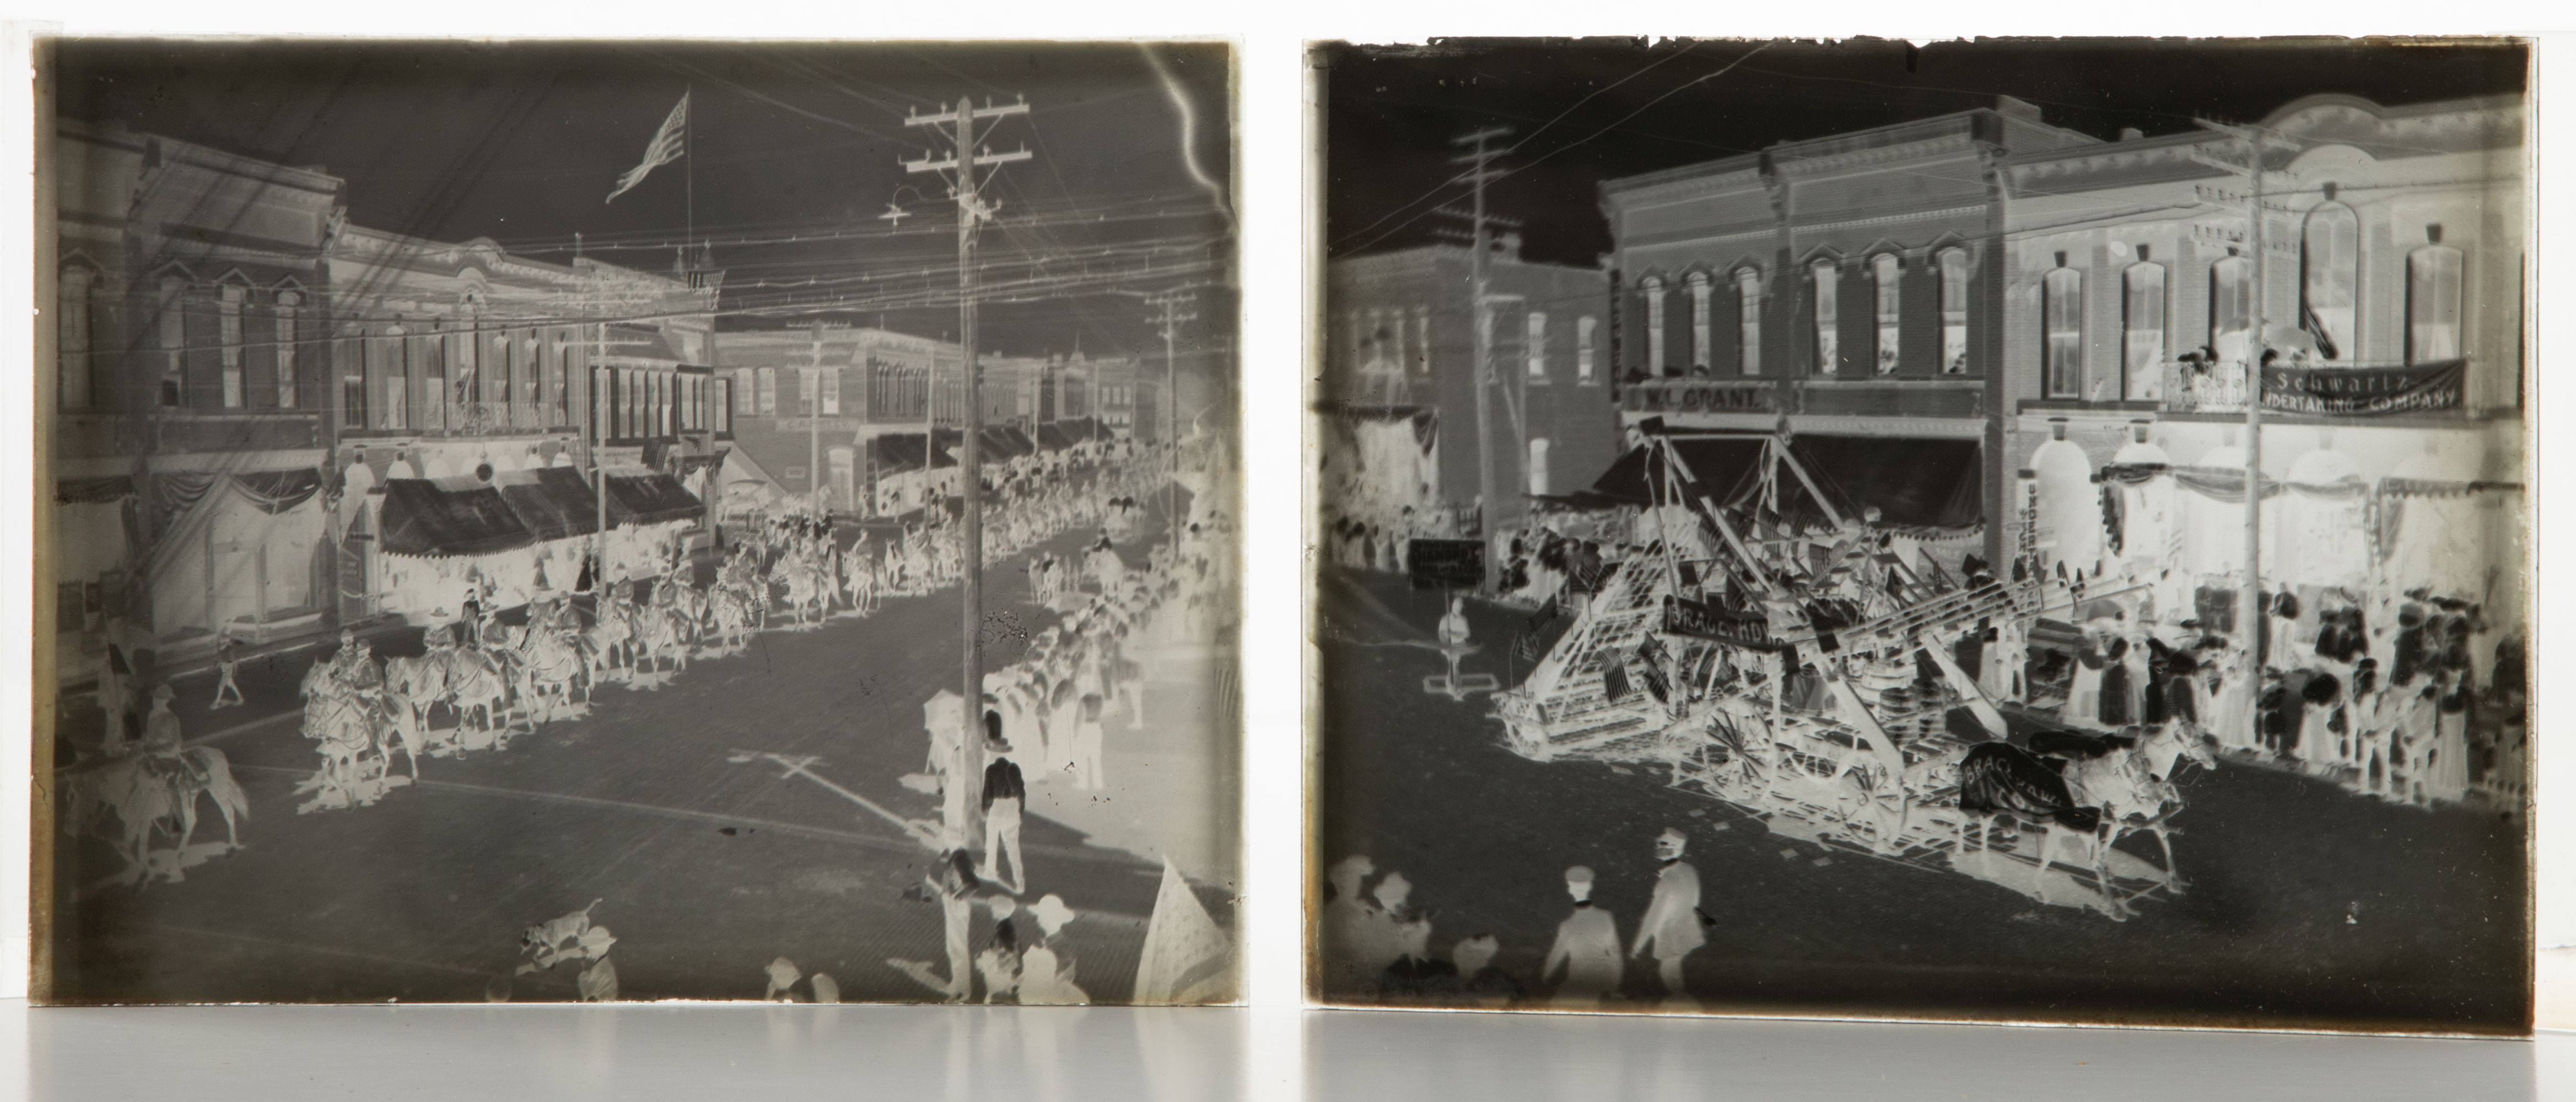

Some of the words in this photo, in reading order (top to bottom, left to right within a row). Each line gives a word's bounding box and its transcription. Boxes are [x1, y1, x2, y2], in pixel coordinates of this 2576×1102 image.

[2277, 371, 2408, 392] Schwartz
[2262, 392, 2354, 412] NDERTAKING
[2369, 389, 2455, 410] COMPANY
